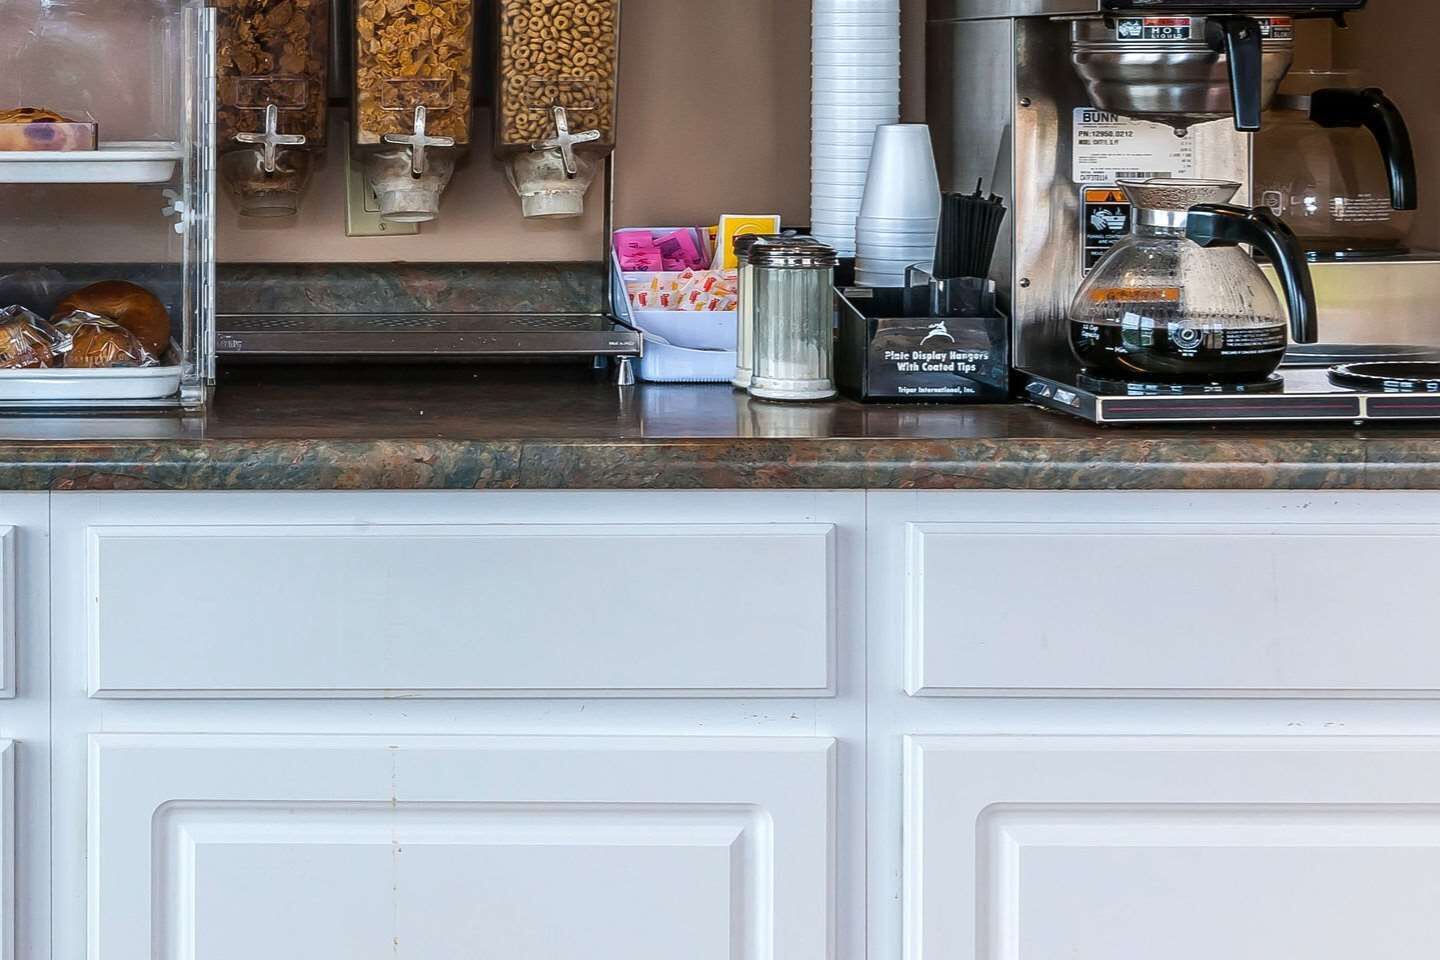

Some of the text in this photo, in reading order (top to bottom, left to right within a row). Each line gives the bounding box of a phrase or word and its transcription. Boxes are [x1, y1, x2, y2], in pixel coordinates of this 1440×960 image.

[1082, 112, 1118, 122] BUNN
[884, 350, 989, 362] Plate Display Hangers
[897, 362, 976, 374] With Coated Tips
